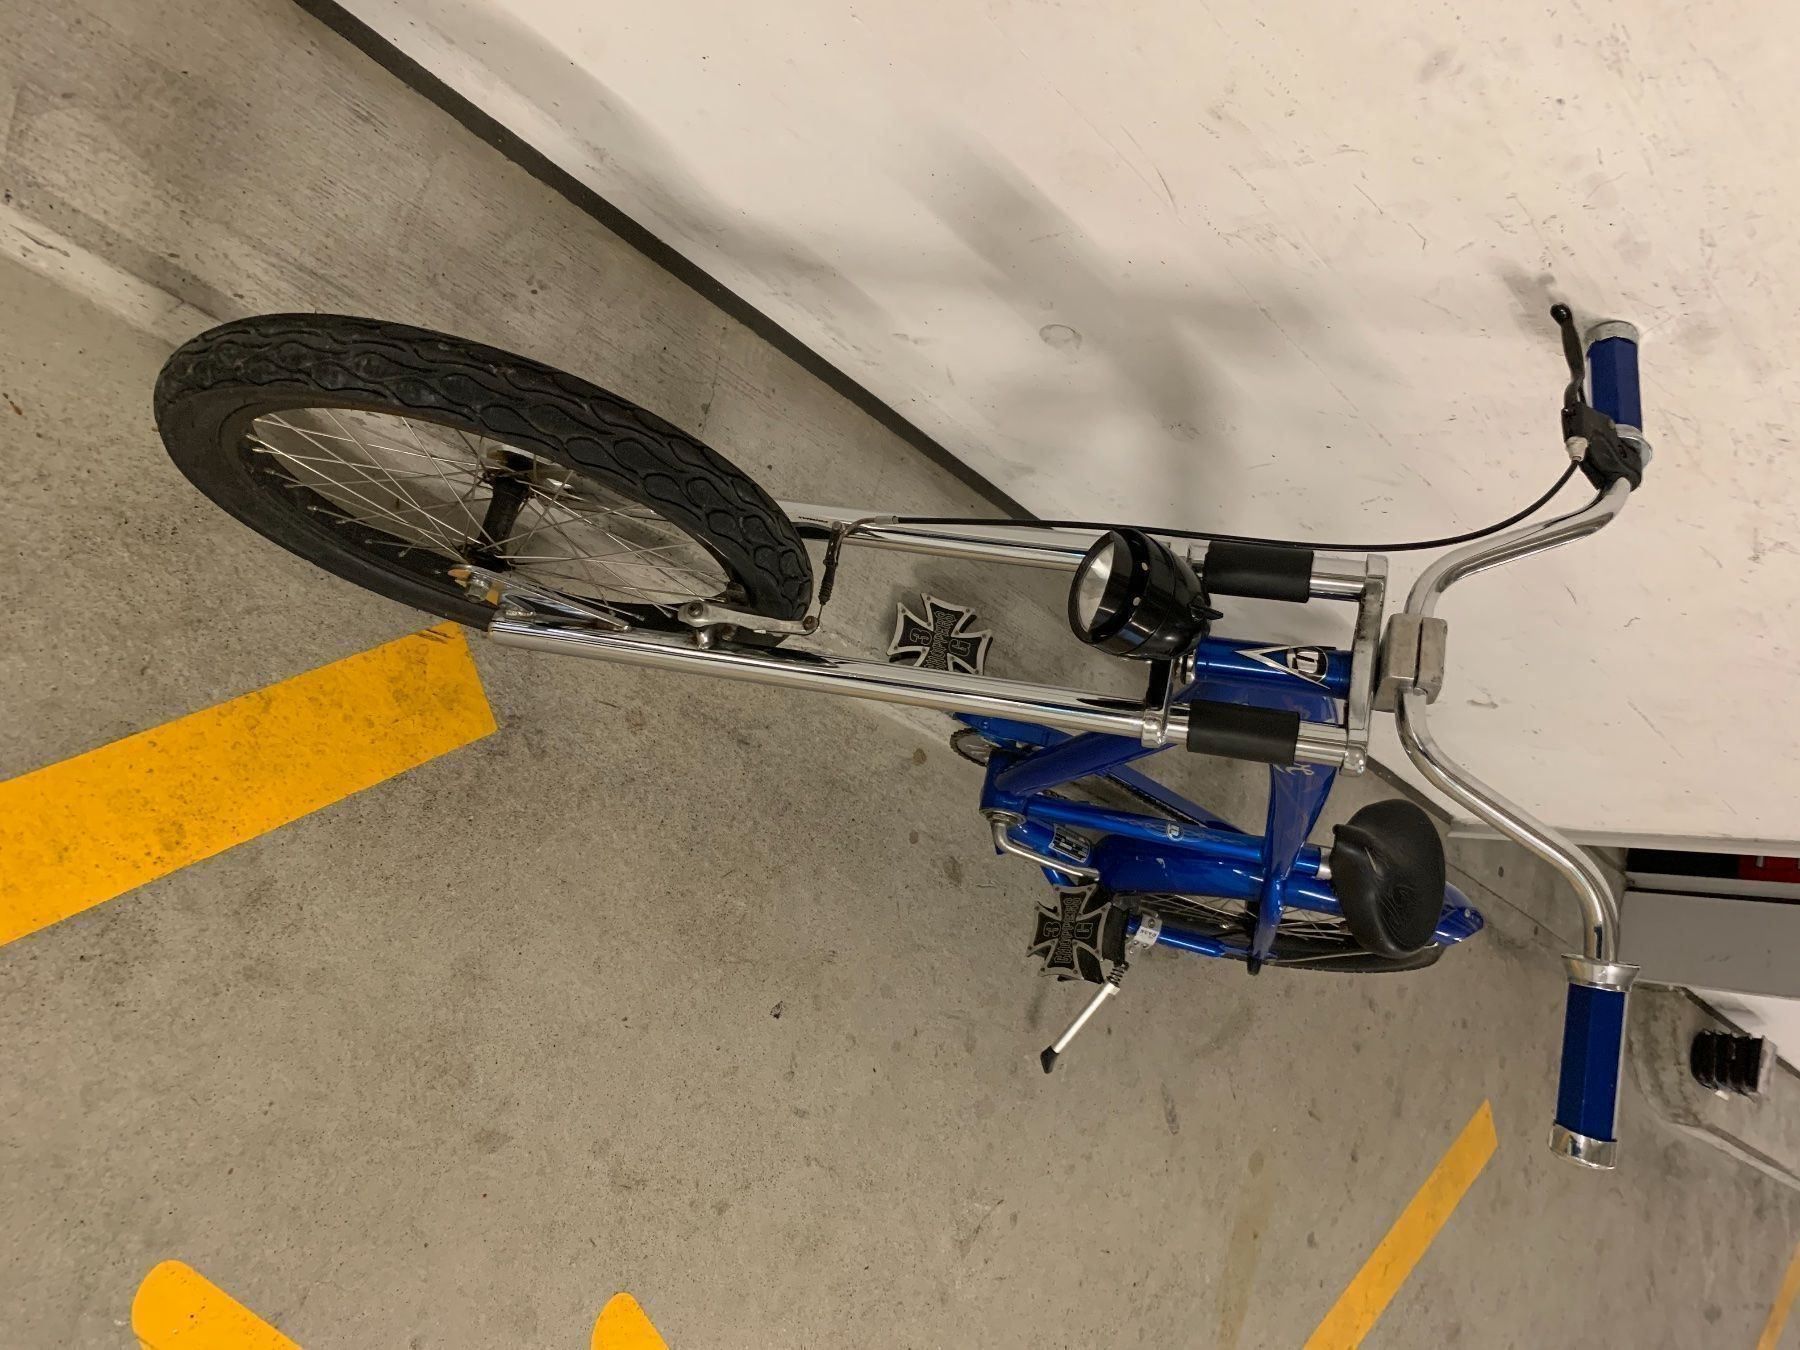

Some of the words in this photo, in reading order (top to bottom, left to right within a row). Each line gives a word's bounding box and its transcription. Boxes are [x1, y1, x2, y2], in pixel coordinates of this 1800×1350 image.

[910, 628, 932, 646] 3
[948, 639, 971, 656] G
[1043, 921, 1061, 937] 3
[1054, 897, 1080, 963] CHOPPERS
[1074, 922, 1093, 939] G
